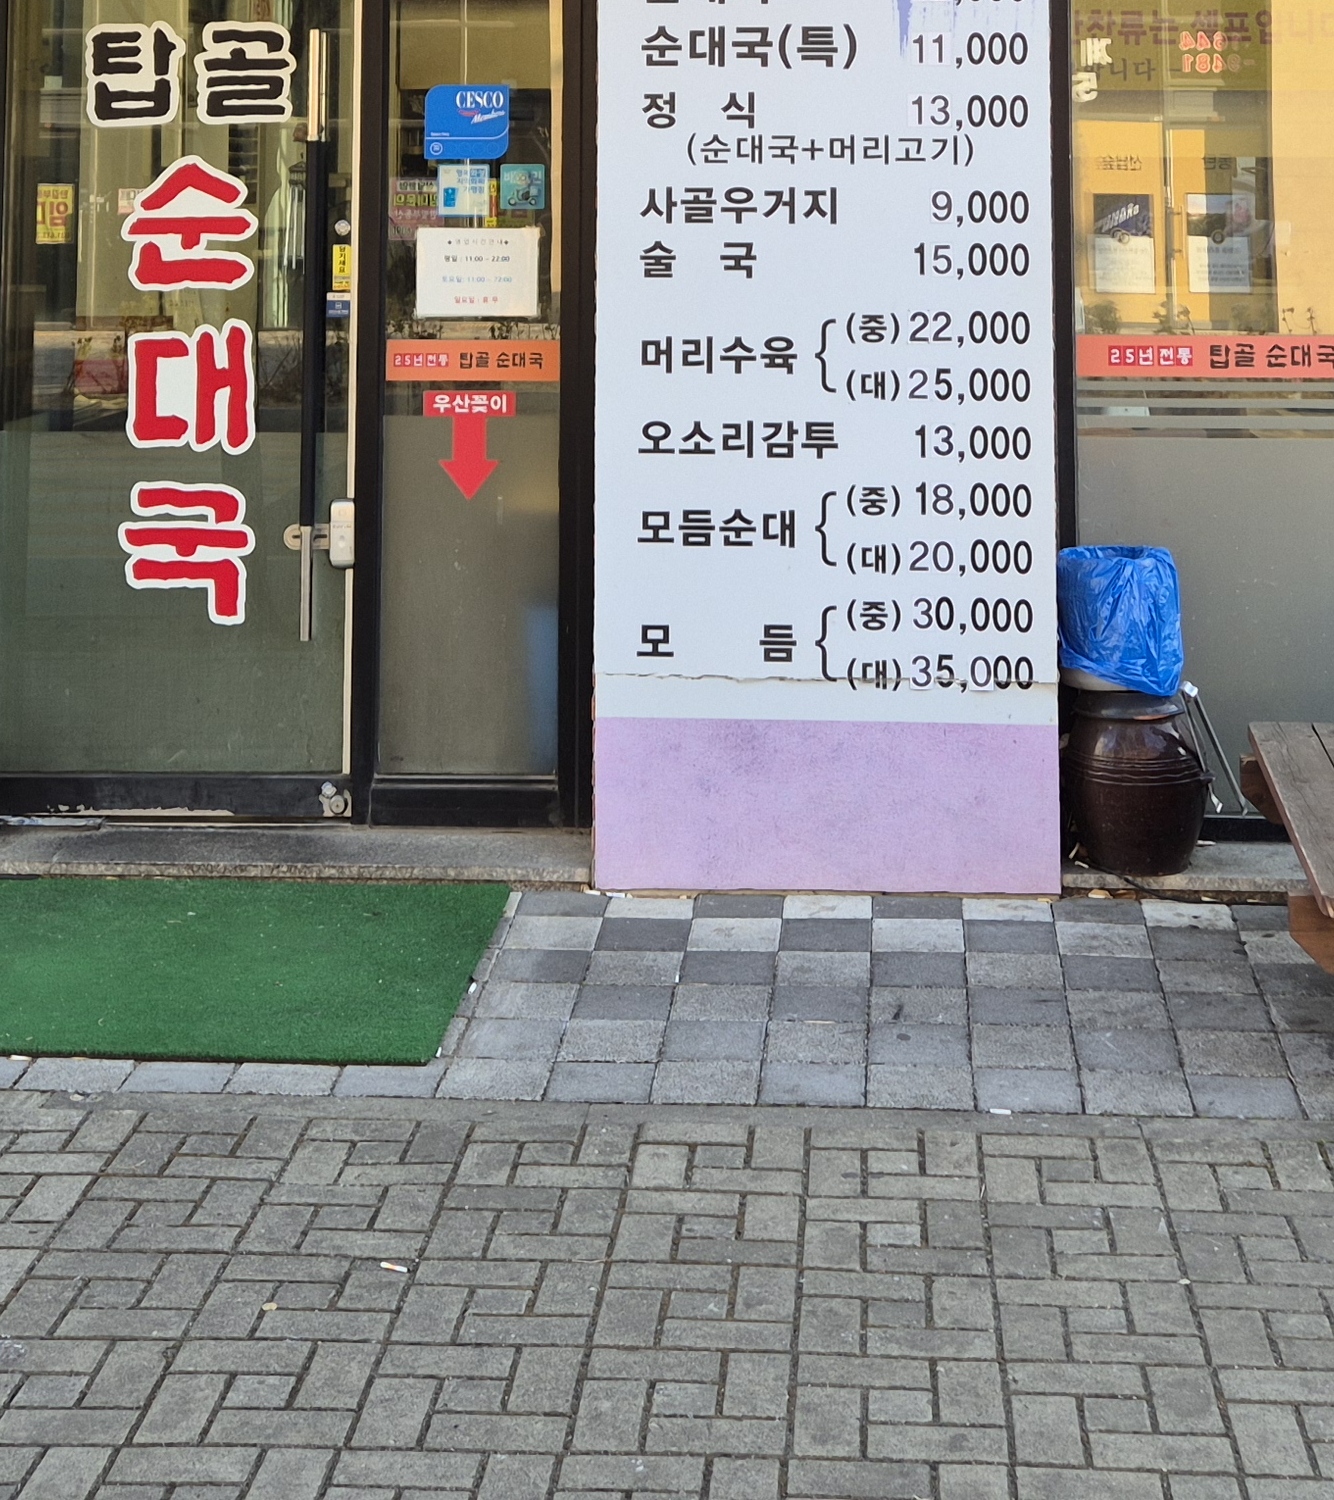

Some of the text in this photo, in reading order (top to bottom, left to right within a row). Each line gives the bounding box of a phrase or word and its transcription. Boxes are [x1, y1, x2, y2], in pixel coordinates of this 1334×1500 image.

[640, 23, 1029, 71] 순대국(특) 11,000
[88, 24, 294, 123] 탑골
[455, 90, 504, 109] CESCO
[909, 93, 1030, 133] 13,000
[686, 131, 975, 168] (순대국+머리고기)
[639, 186, 1030, 228] 사골우거지 9,000
[913, 241, 1031, 281] 15,000
[844, 310, 1031, 348] (중) 22,000
[459, 351, 490, 369] 탑골
[495, 351, 544, 370] 순대국
[639, 335, 799, 375] 머리수육
[1110, 347, 1154, 365] 25년
[1209, 342, 1256, 369] 탑골
[122, 159, 253, 622] 순대국
[844, 366, 1032, 405] (대) 25,000
[637, 420, 1032, 464] 오소리감투 13,000
[845, 481, 1033, 520] (중) 18,000
[636, 508, 797, 549] 모듬순대
[845, 538, 1033, 578] (대) 20,000
[845, 598, 903, 632] (중)
[911, 596, 1034, 635] 30,000
[845, 654, 1035, 693] (대) 35,000
